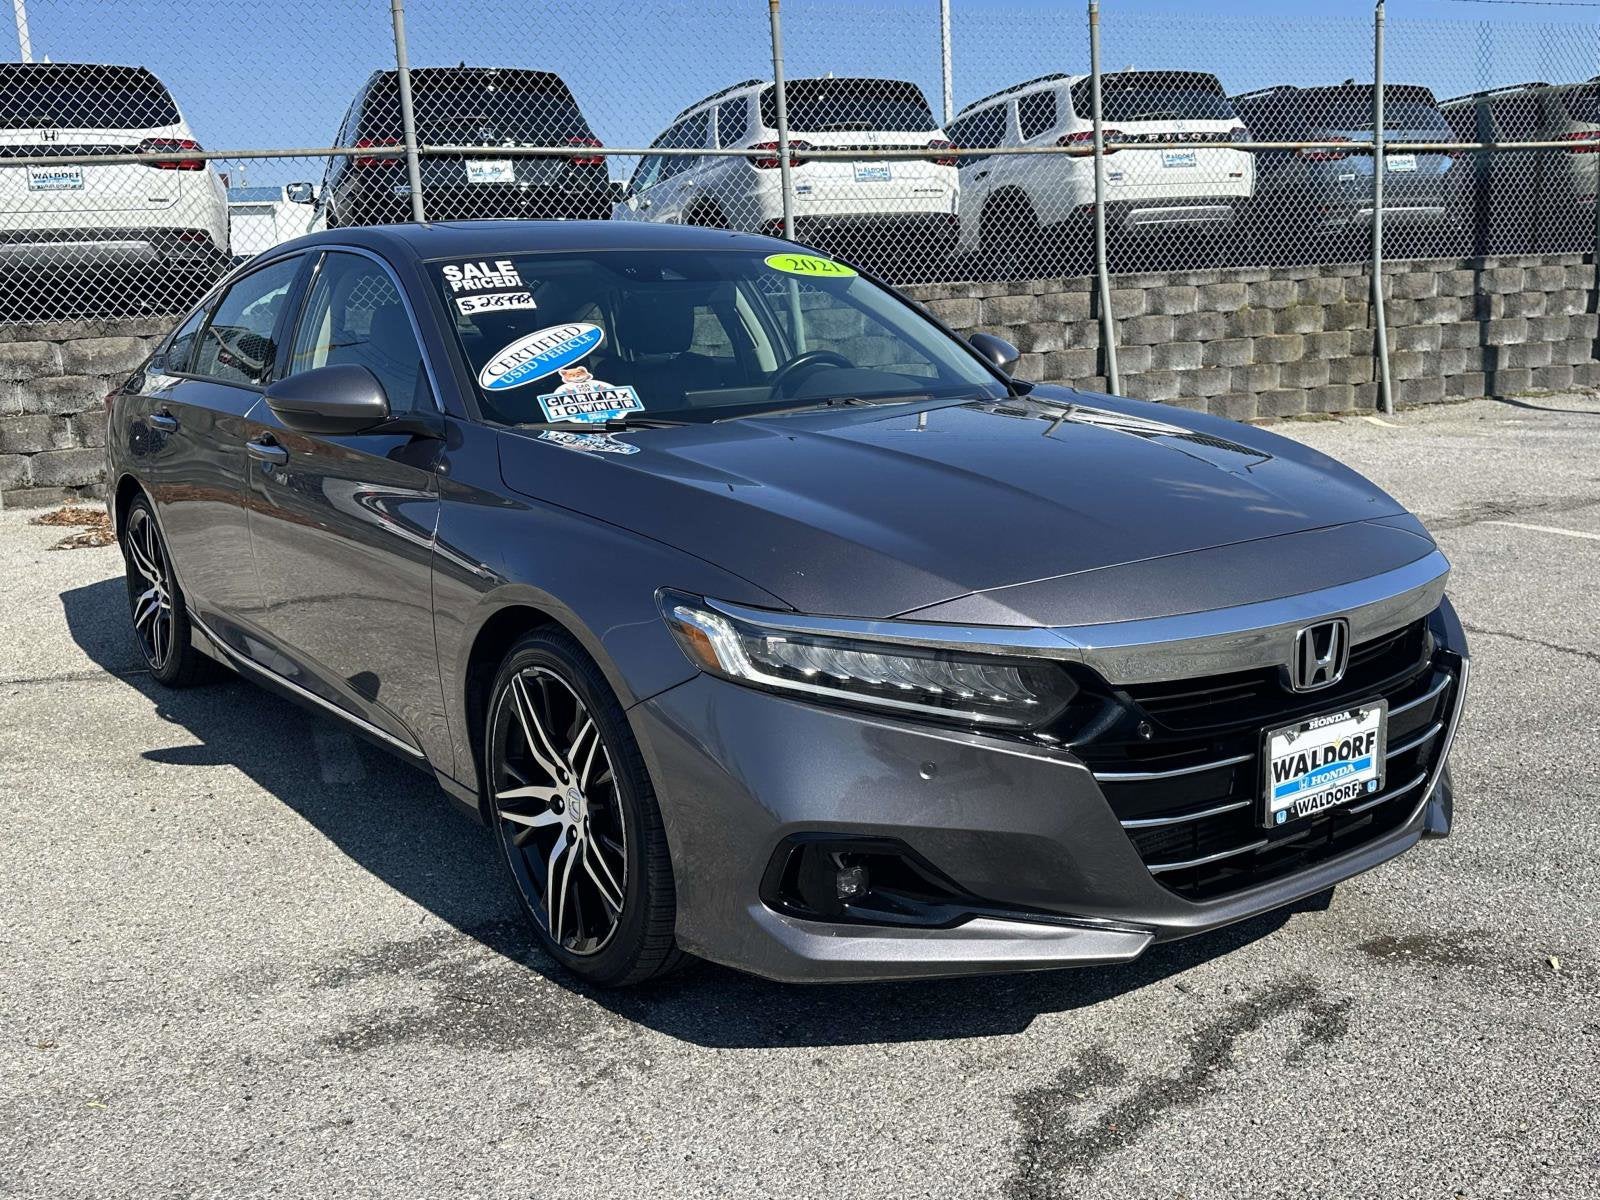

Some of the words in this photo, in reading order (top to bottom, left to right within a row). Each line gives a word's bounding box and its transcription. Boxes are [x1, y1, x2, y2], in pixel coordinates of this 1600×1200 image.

[31, 172, 80, 180] WALDORF
[442, 260, 519, 282] SALE
[786, 258, 842, 273] 2021
[450, 275, 523, 293] PRICED!
[488, 326, 582, 377] CERTIFIED
[501, 360, 540, 384] USED
[537, 333, 595, 363] VEHICLE
[545, 390, 630, 407] CARFAX
[565, 399, 636, 414] OWNER
[1308, 711, 1352, 730] HONDA
[1272, 731, 1377, 783] WALDORF
[1310, 763, 1356, 785] HONDA
[1297, 782, 1359, 815] WALDORF
